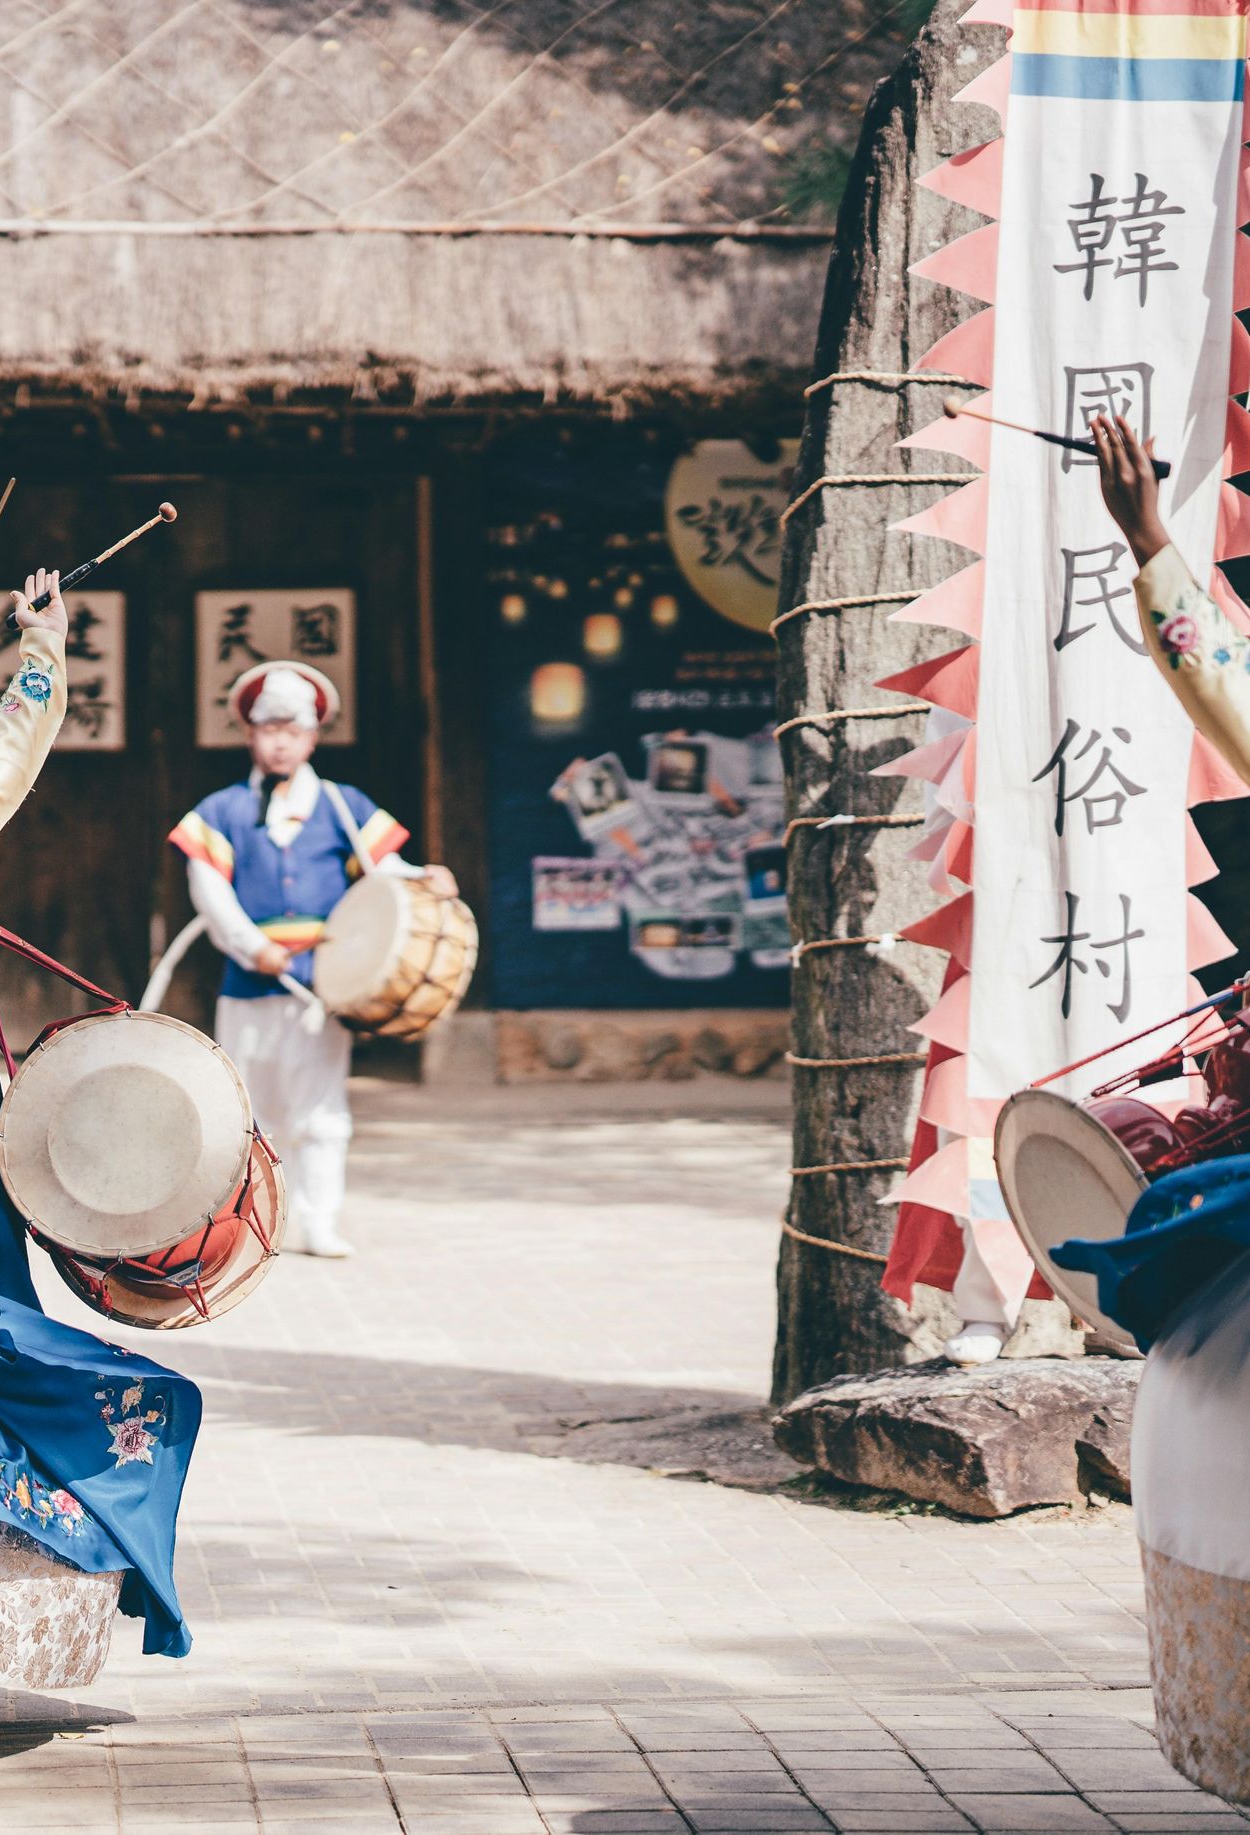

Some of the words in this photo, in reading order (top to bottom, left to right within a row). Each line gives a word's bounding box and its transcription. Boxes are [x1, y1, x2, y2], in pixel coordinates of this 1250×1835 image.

[1029, 171, 1186, 1024] 韓國民俗村
